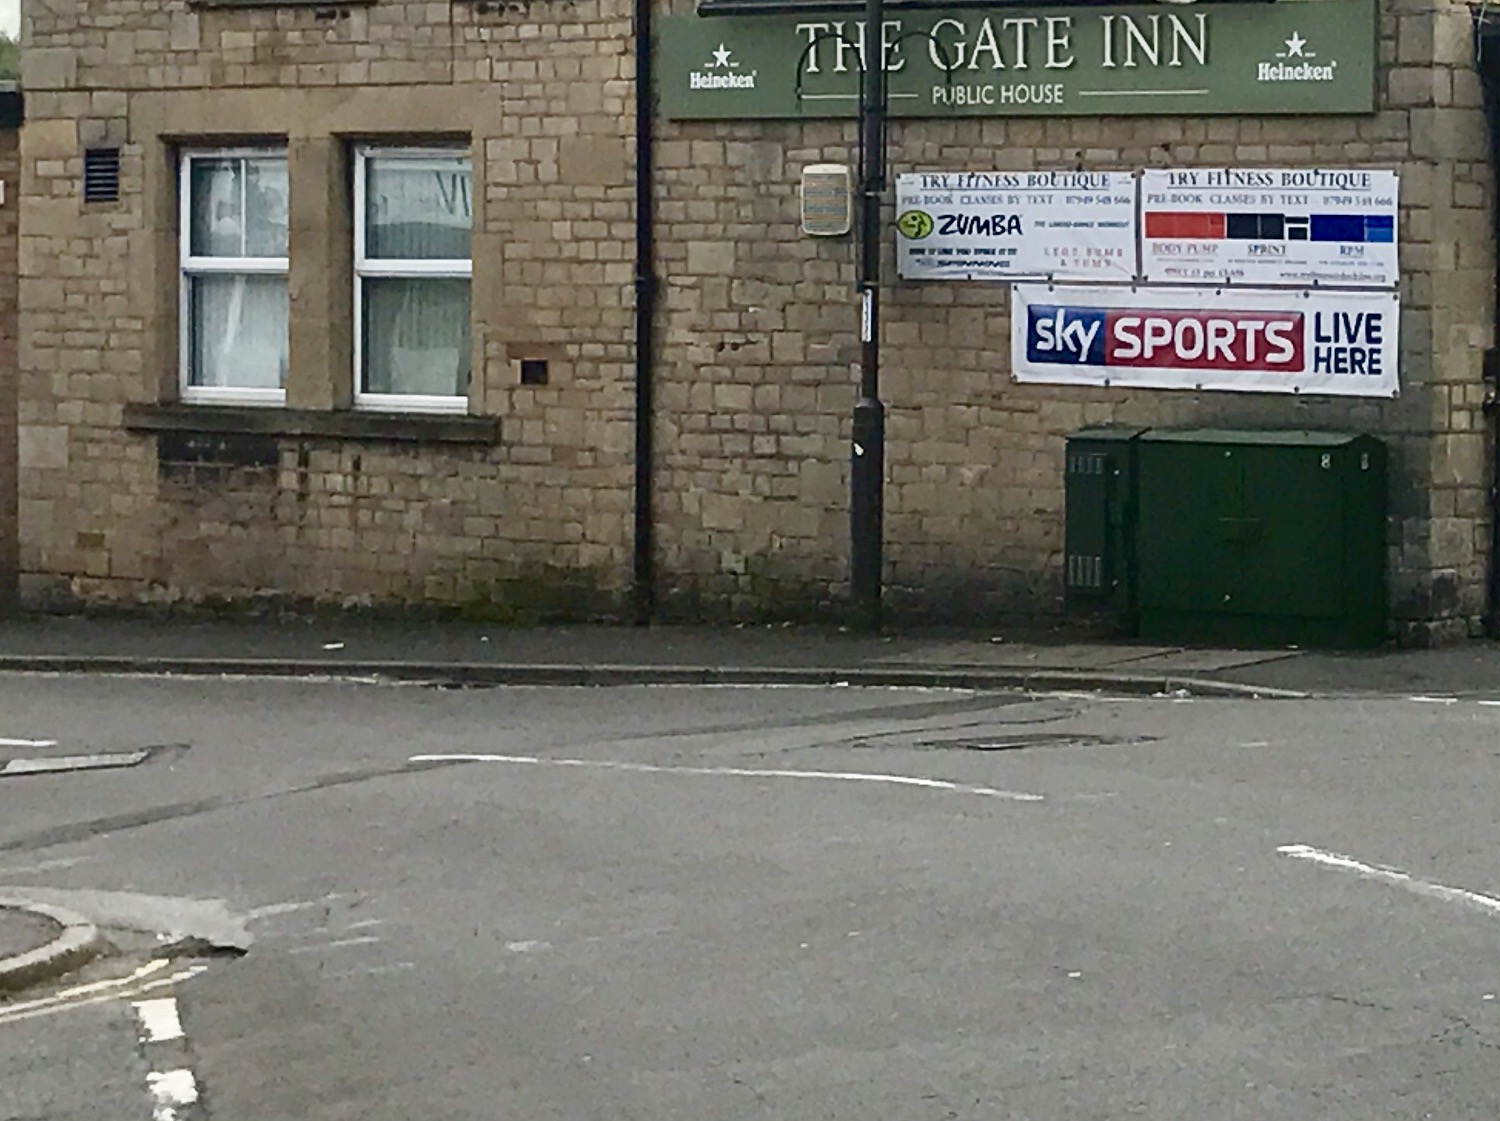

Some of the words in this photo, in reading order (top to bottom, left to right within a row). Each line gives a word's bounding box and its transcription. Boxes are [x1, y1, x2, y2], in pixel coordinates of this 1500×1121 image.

[795, 20, 906, 74] THE
[928, 15, 1076, 72] GATE
[1102, 14, 1209, 68] INN
[690, 71, 755, 89] Heineken
[1257, 61, 1334, 81] Heineken
[932, 84, 995, 106] PUBLIC
[1001, 84, 1065, 105] HOUSE
[919, 174, 948, 189] TRY
[957, 174, 1020, 188] FITNESS
[1028, 173, 1111, 190] BOUTIQUE
[1167, 171, 1199, 186] TRY
[1207, 171, 1274, 186] FITNESS
[1281, 172, 1372, 190] BOUTIQUE
[937, 213, 1024, 236] ZUMBA
[1035, 309, 1101, 361] sky
[1113, 316, 1295, 365] SPORTS
[1314, 312, 1383, 345] LIVE
[1314, 346, 1383, 375] HERE
